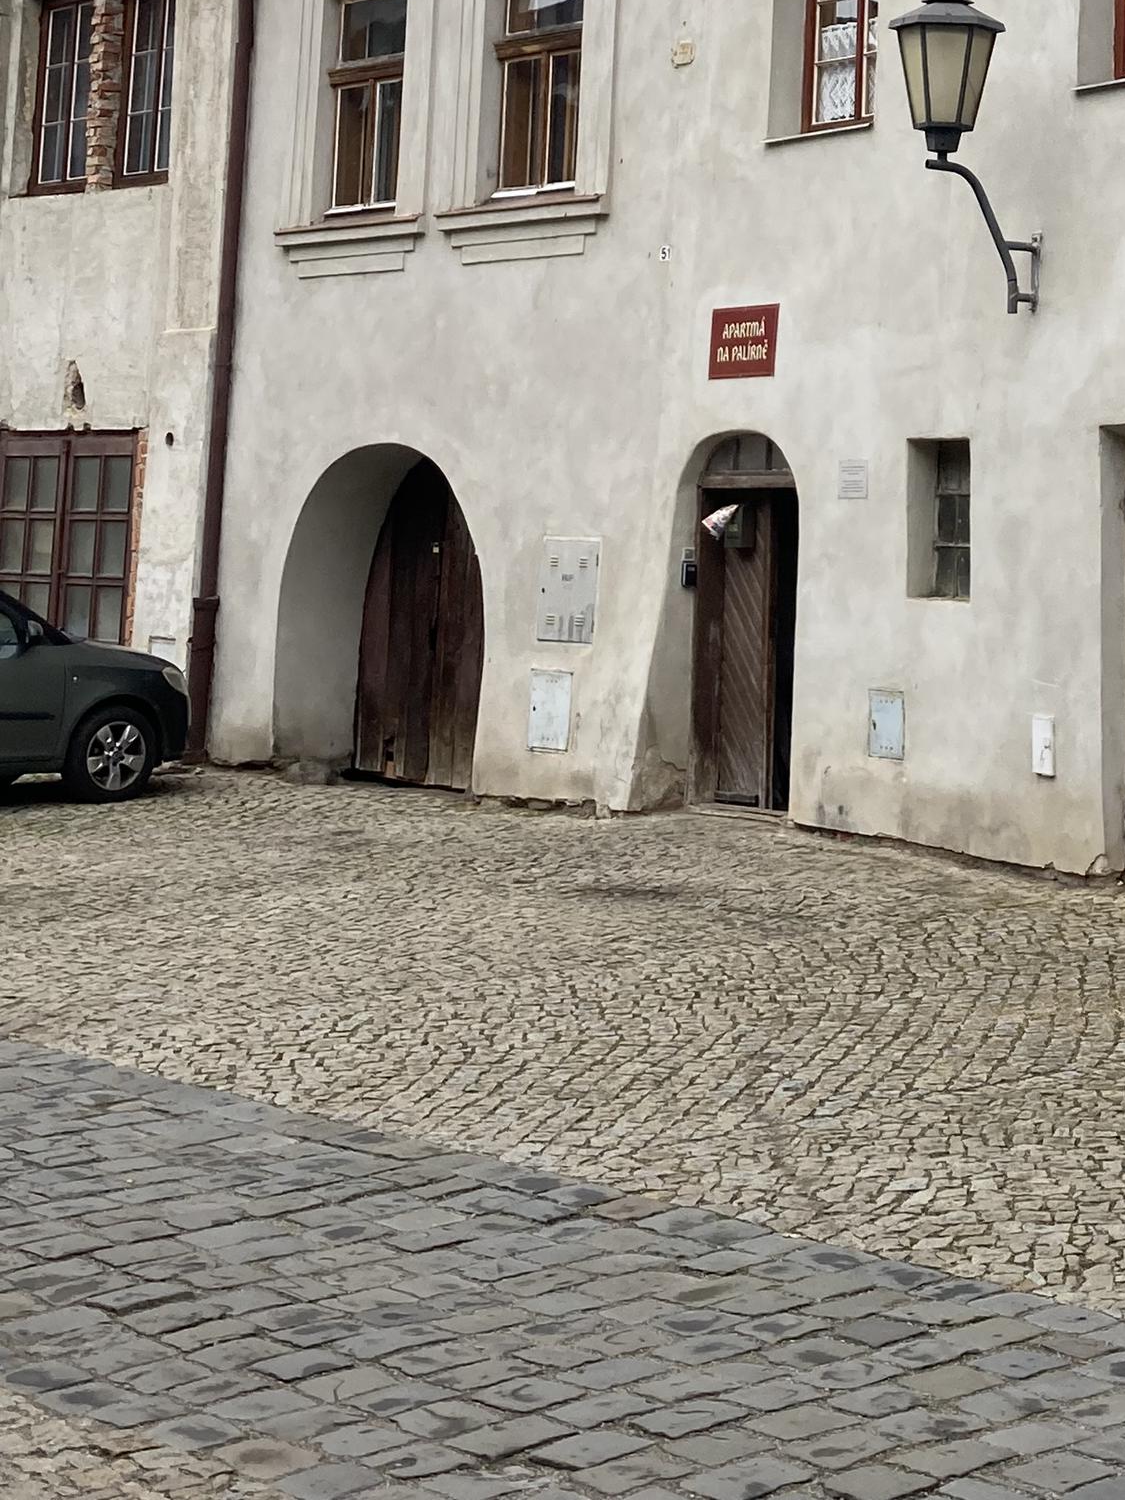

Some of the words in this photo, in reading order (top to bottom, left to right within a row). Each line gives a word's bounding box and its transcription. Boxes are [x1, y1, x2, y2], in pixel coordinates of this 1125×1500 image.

[661, 247, 671, 260] 51
[722, 315, 766, 340] APARTMÁ
[716, 345, 729, 363] NA
[731, 339, 769, 363] PALÍRNĚ
